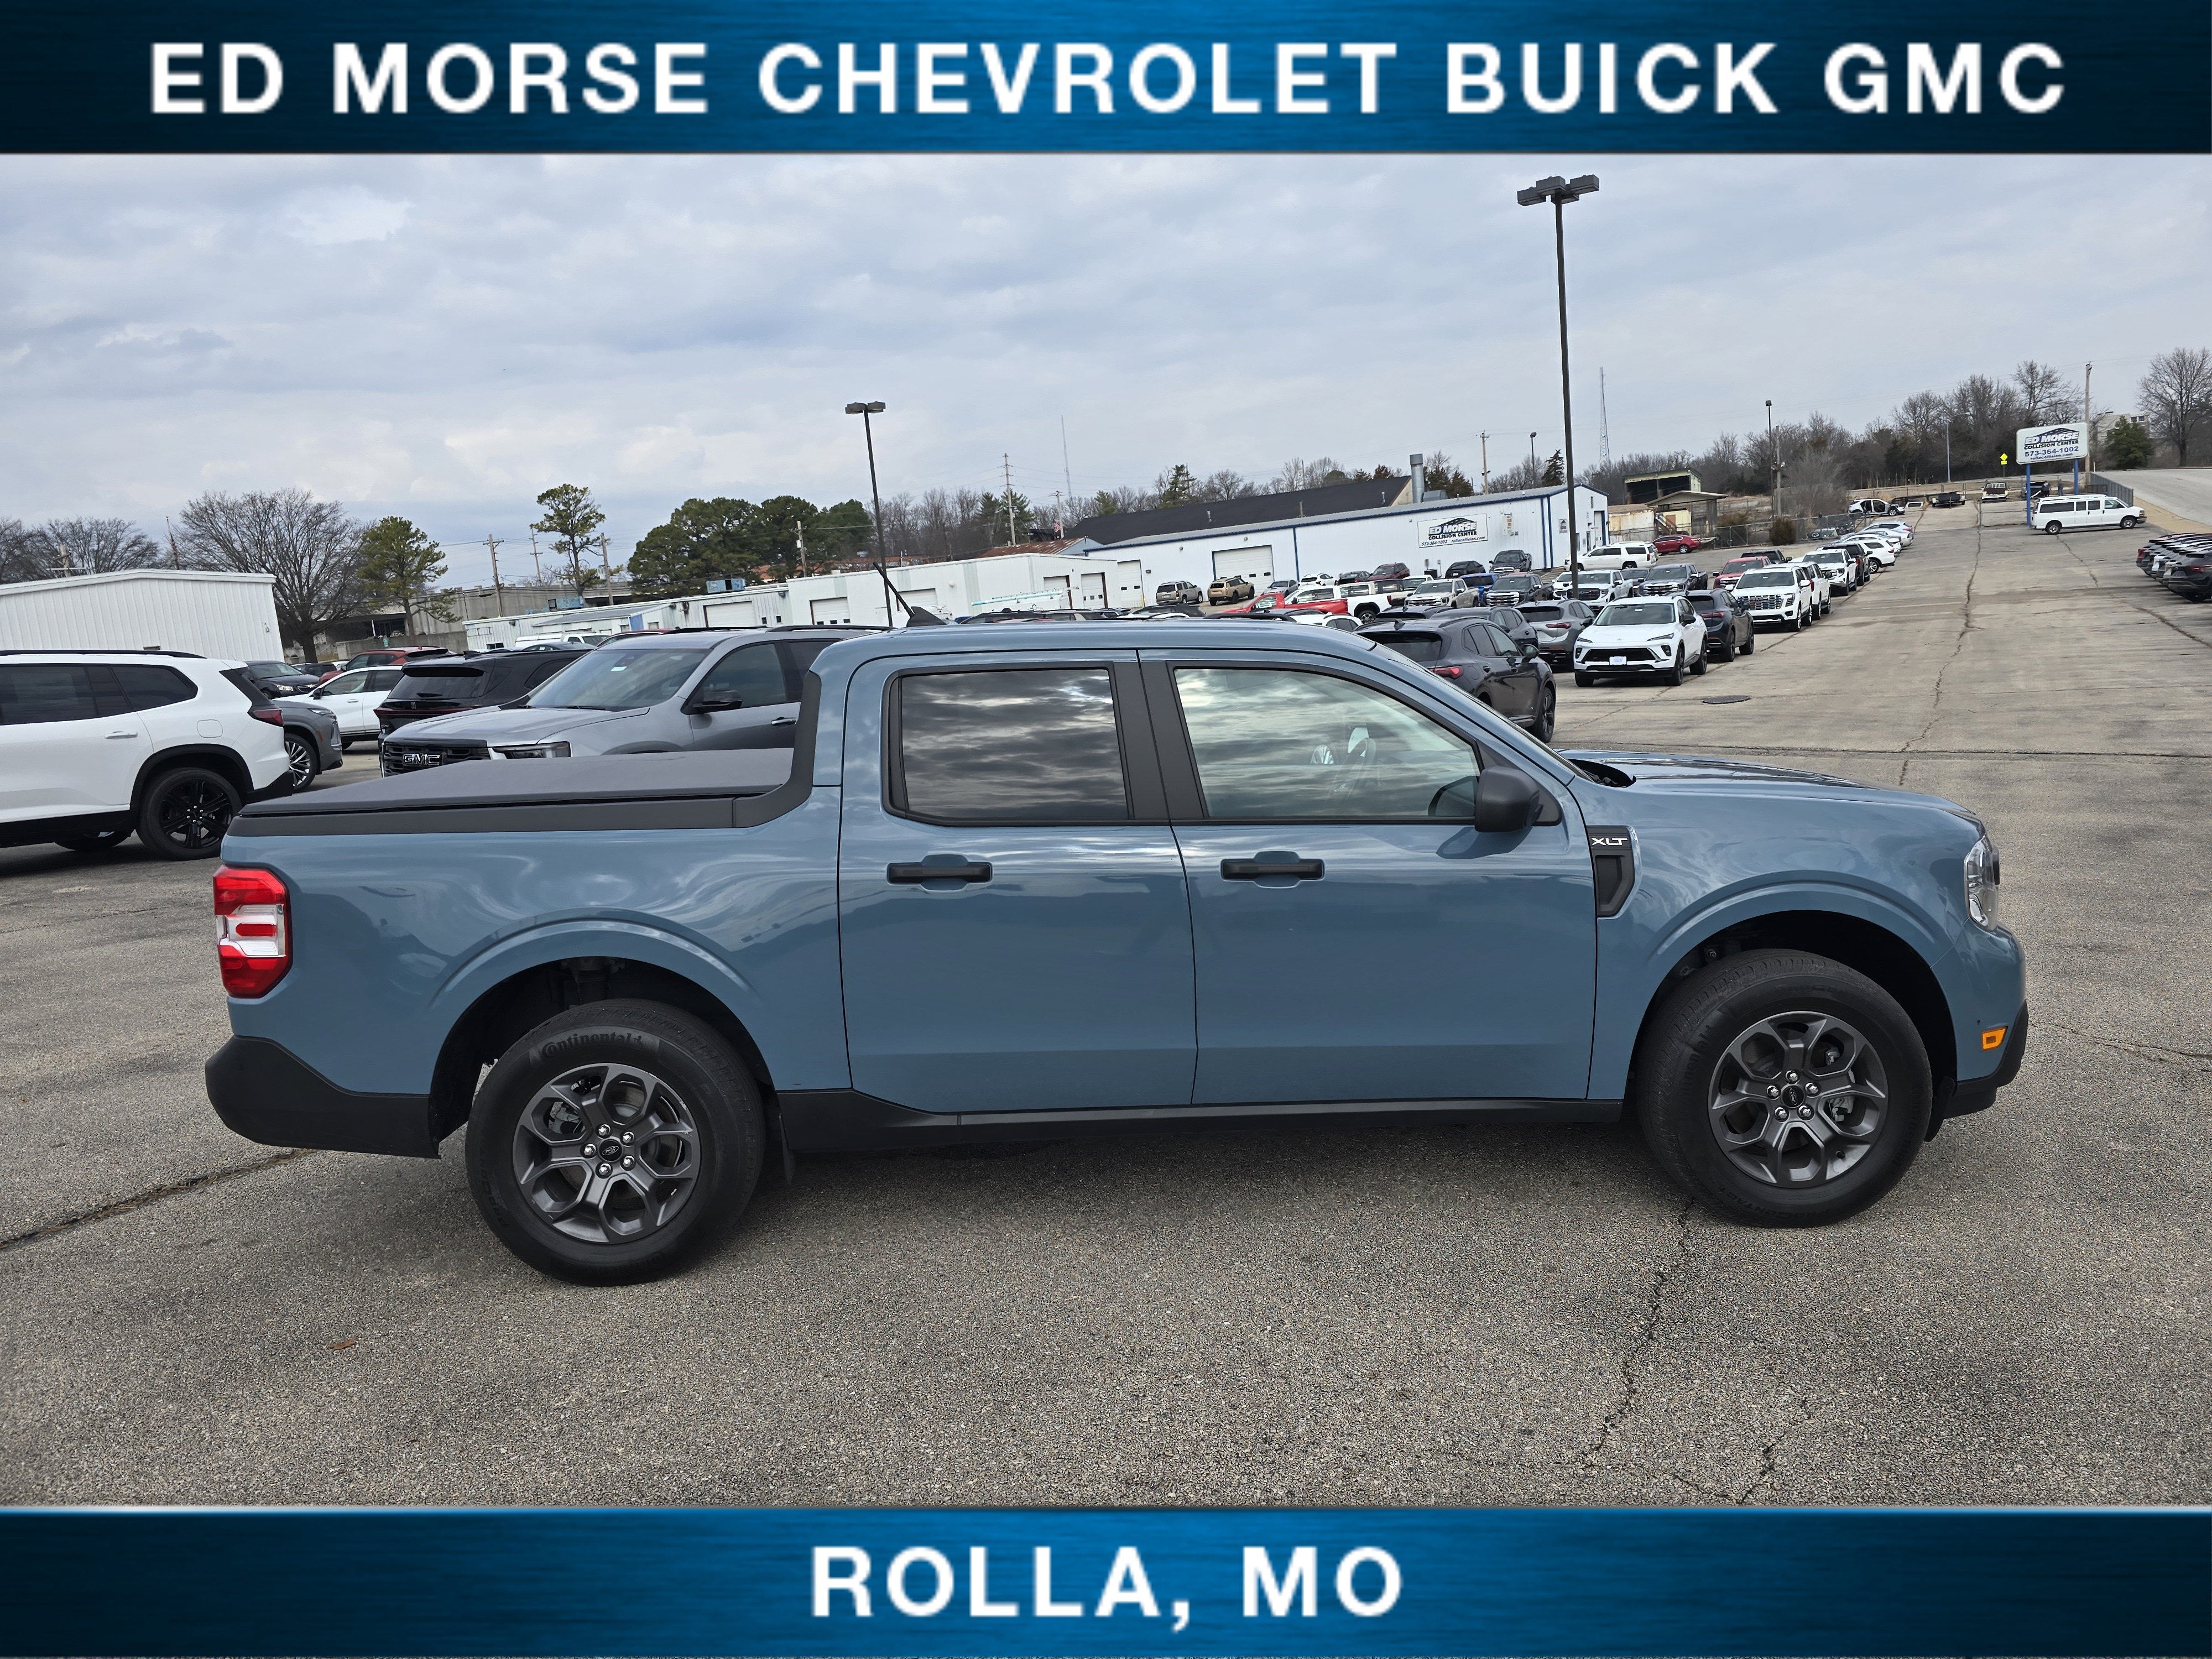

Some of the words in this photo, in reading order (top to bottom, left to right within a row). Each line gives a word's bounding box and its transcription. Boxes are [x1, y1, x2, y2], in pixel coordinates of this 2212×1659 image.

[2041, 431, 2079, 443] MORSE
[2025, 446, 2079, 457] 573-364-1002
[1429, 526, 1442, 535] ED
[1443, 521, 1477, 533] MORSE
[403, 753, 440, 766] GMC
[1591, 837, 1628, 846] XLT
[542, 1032, 632, 1061] Continental
